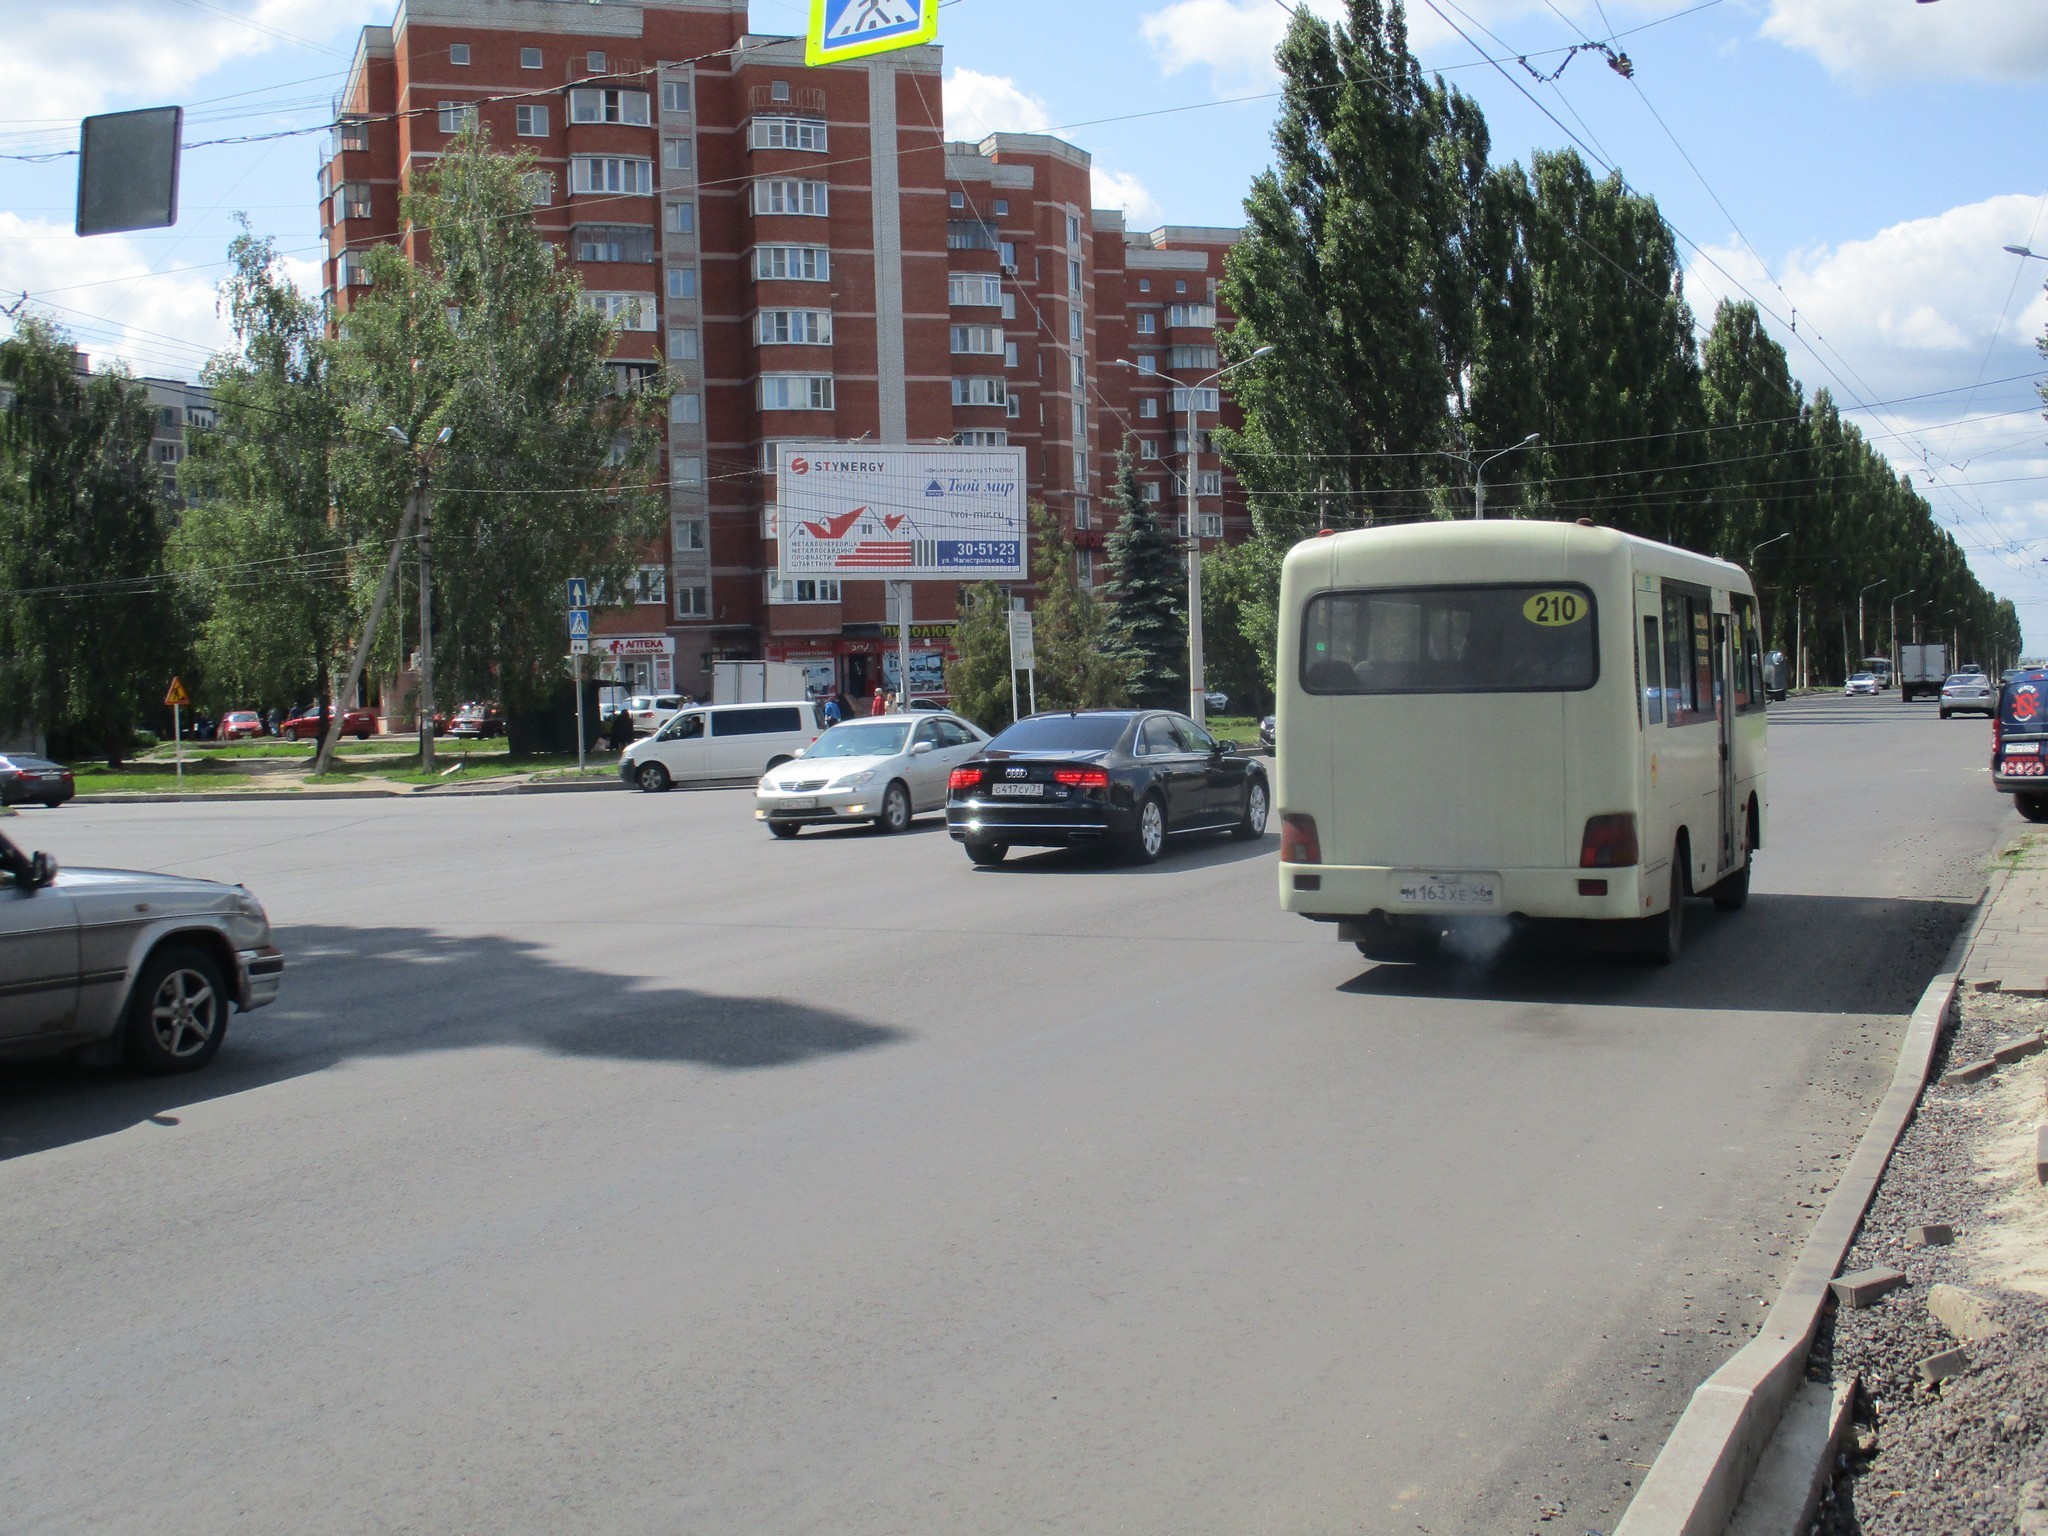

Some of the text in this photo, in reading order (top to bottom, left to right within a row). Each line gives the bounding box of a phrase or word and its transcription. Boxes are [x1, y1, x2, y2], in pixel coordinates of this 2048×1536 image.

[815, 461, 885, 472] STYNERGY
[948, 478, 980, 492] Твой
[983, 482, 1014, 497] мир
[950, 509, 1004, 518] tvoi-mir.ru
[1536, 595, 1576, 621] 210
[625, 640, 664, 648] АПТЕКА
